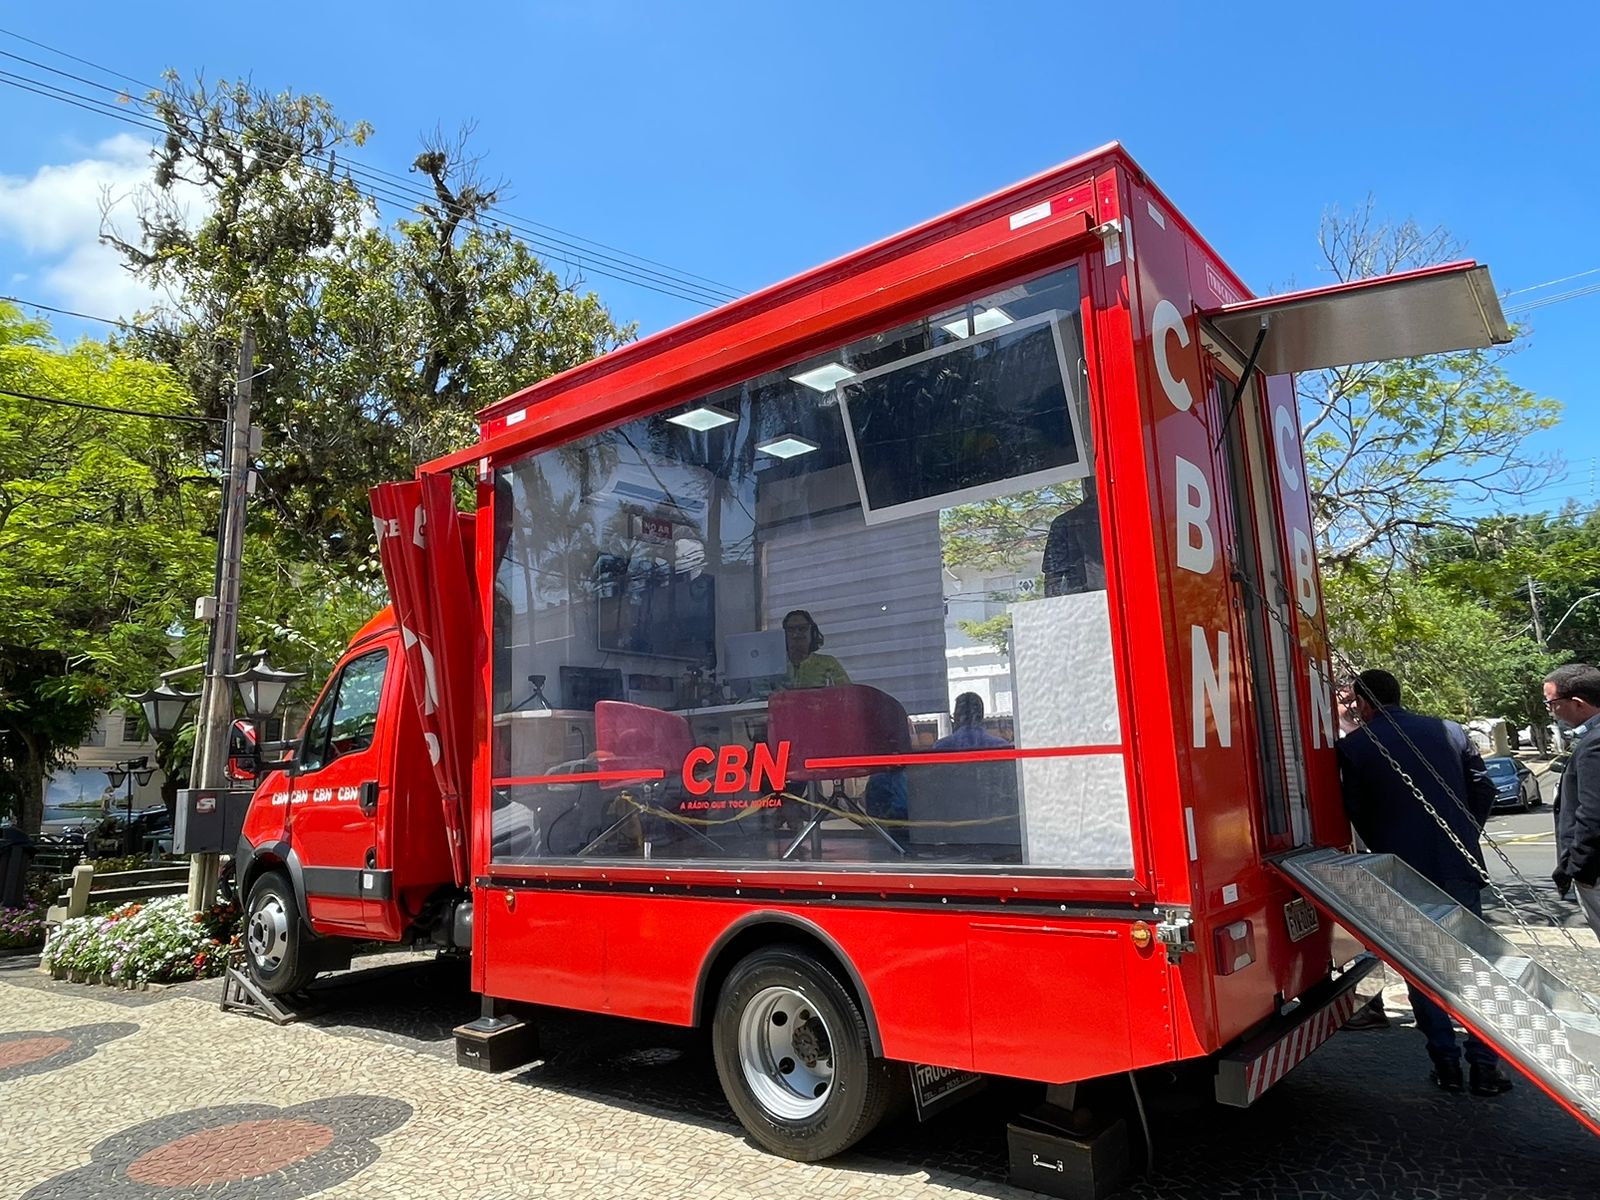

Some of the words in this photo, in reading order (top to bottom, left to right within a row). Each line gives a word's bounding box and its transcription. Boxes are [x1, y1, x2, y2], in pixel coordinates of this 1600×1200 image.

[1152, 300, 1232, 748] CBN
[1275, 405, 1334, 749] CBN
[682, 741, 790, 795] CBN
[272, 792, 289, 805] CBN
[291, 790, 308, 803] CBN
[313, 788, 333, 802] CBN
[337, 787, 359, 801] CBN
[687, 800, 710, 810] RÁDIO
[711, 801, 726, 810] QUE
[729, 800, 748, 809] TOCA
